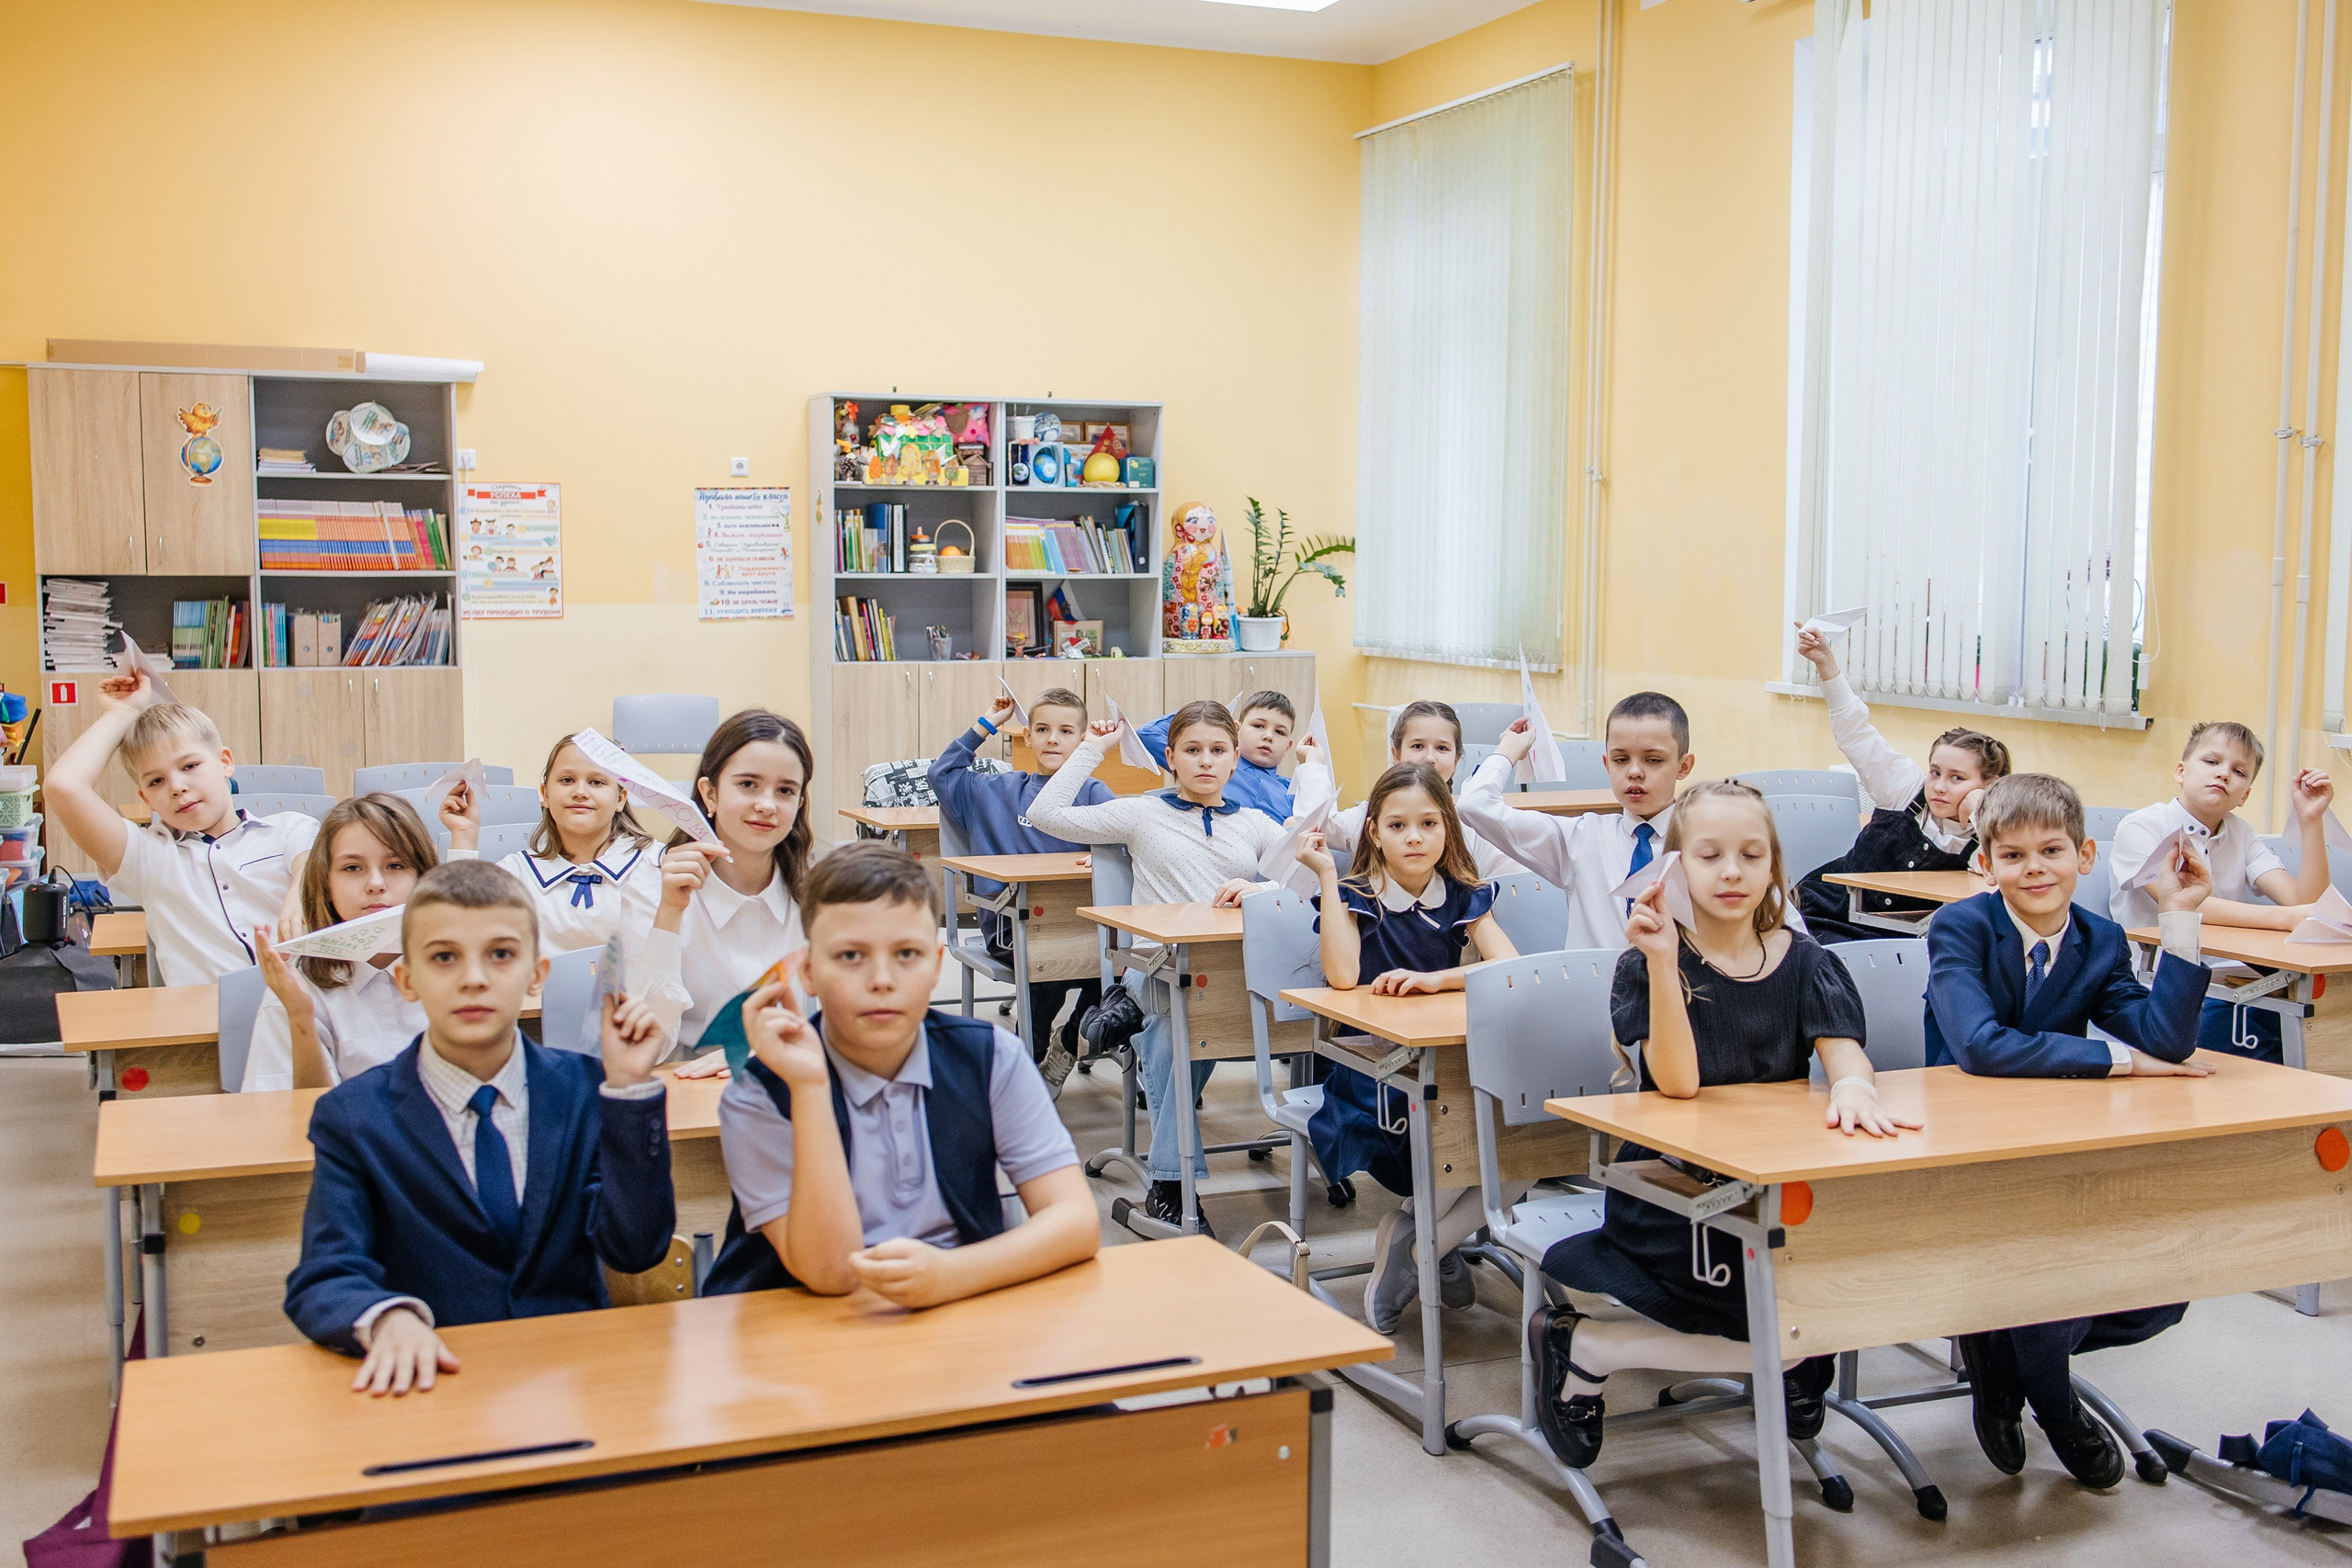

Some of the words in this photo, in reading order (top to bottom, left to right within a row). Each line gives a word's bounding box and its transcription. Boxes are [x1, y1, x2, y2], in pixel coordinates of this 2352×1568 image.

[490, 491, 522, 499] УСПЕХА
[699, 491, 733, 504] Правила
[735, 492, 761, 502] нашего
[763, 492, 788, 502] класса
